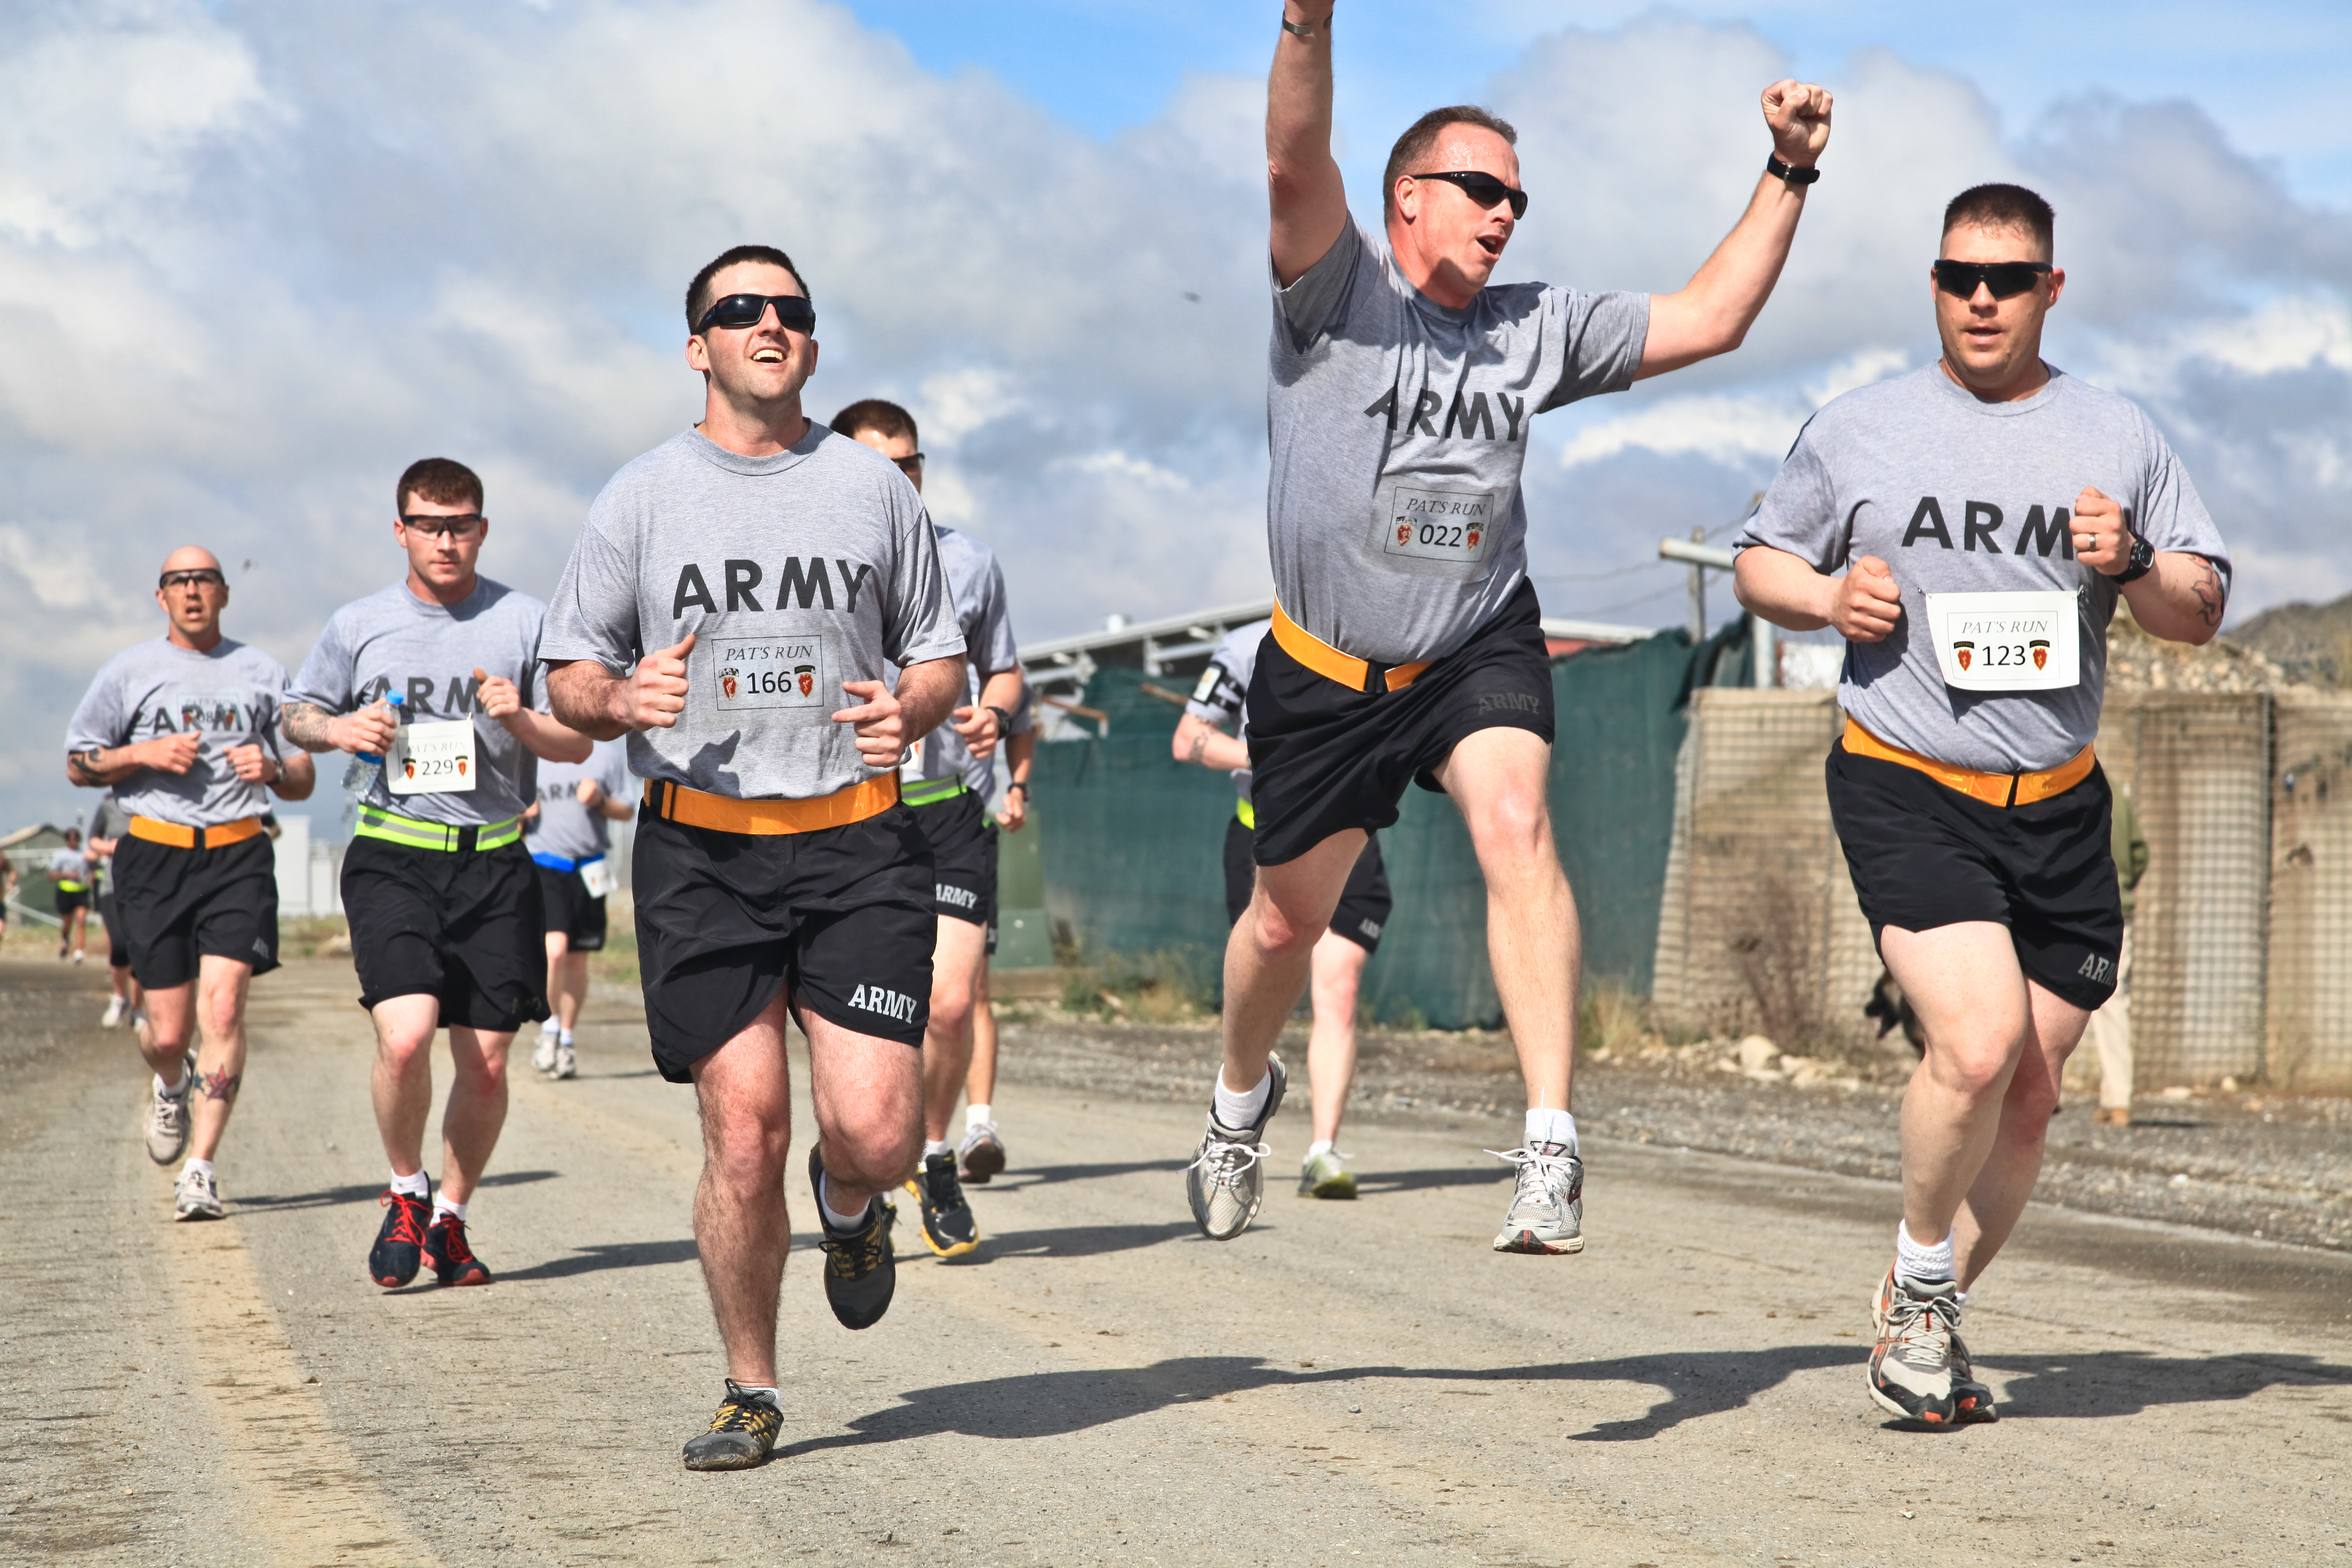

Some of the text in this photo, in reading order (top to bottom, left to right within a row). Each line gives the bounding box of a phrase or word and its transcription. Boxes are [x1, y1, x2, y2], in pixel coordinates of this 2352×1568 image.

[1363, 384, 1524, 441] ARMY
[1406, 498, 1486, 516] PAT'S RUN
[1419, 524, 1462, 547] 022
[1901, 496, 2073, 561] ARM
[673, 557, 872, 619] ARMY
[1961, 620, 2048, 634] PAT'S RUN
[725, 645, 813, 661] PAT'S RUN
[1982, 645, 2026, 666] 123
[747, 671, 792, 694] 166
[372, 676, 483, 714] ARM
[1478, 692, 1540, 715] ARMY
[153, 703, 260, 735] ARMY
[441, 740, 466, 751] RUN
[421, 759, 453, 775] 229
[936, 883, 978, 909] ARMY
[848, 984, 917, 1024] ARMY
